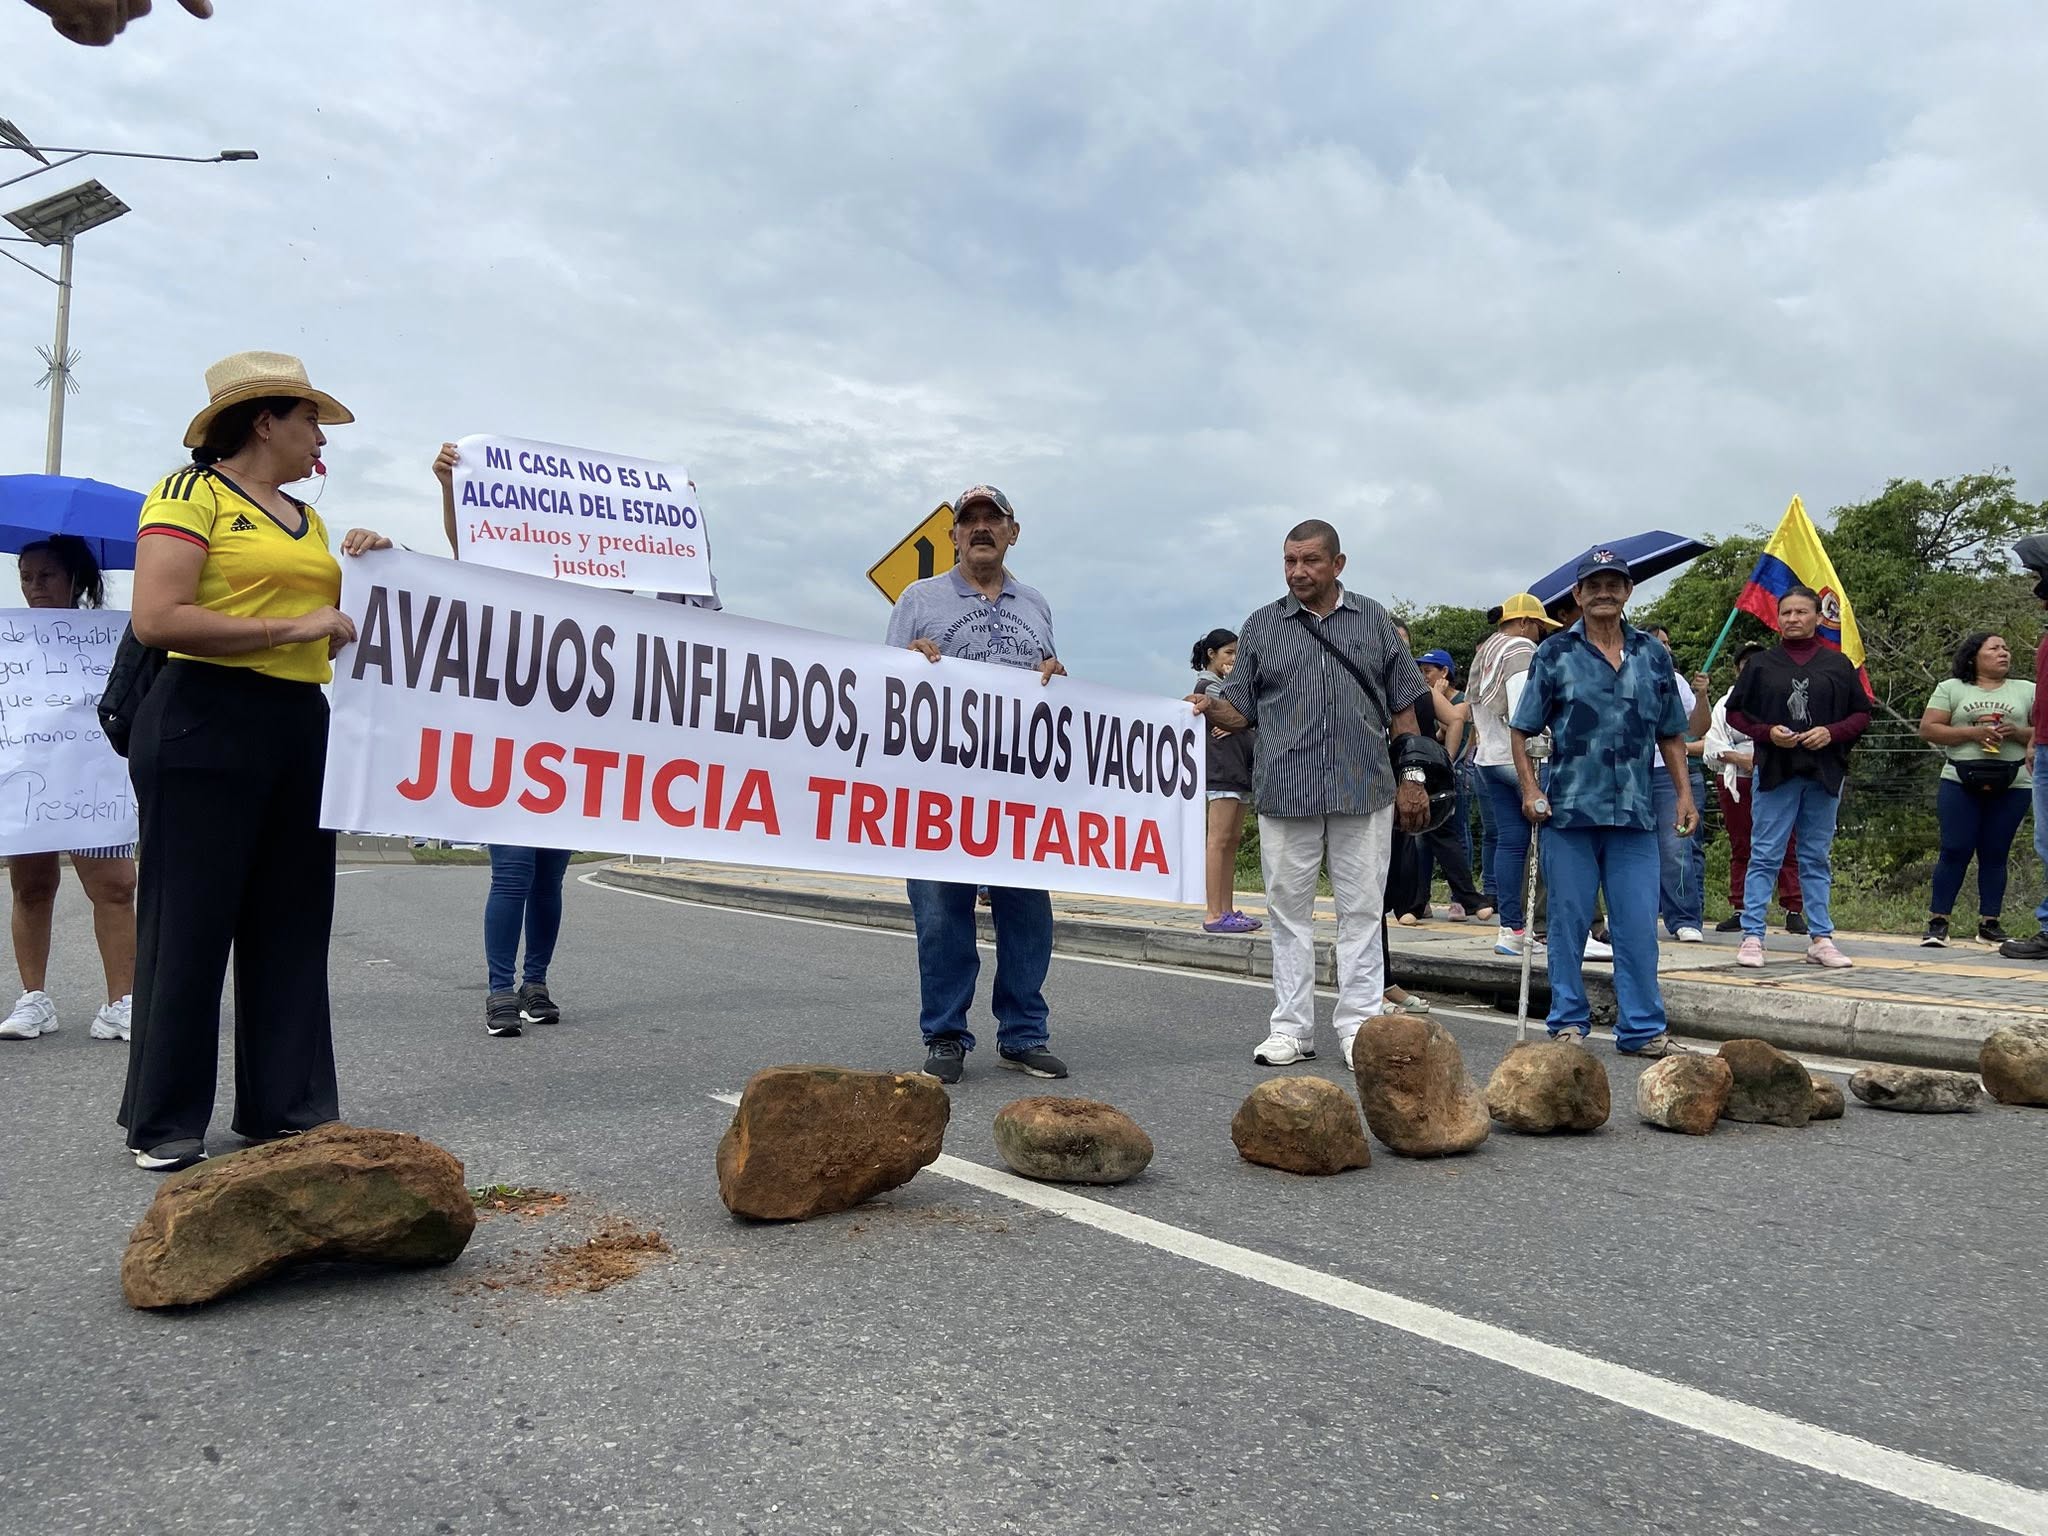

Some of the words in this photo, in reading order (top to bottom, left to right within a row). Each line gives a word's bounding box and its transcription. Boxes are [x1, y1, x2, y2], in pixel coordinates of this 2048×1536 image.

[486, 445, 512, 471] MI
[519, 452, 574, 479] CASA
[578, 461, 612, 484] NO
[617, 467, 641, 488] ES
[645, 471, 672, 492] LA
[462, 480, 573, 515] ALCANCIA
[579, 493, 617, 521] DEL
[623, 499, 697, 529] ESTADO
[470, 519, 572, 545] ¡Avaluos
[578, 533, 591, 552] y
[598, 532, 696, 558] prediales
[553, 553, 626, 578] justos!
[1, 620, 25, 643] de
[33, 624, 50, 645] la
[1000, 609, 1041, 646] OARDWALK
[351, 585, 616, 718] AVALUOS
[632, 633, 869, 768] INFLADOS,
[883, 676, 1072, 783] BOLSILLOS
[1083, 711, 1198, 801] VACIOS
[1963, 702, 2014, 713] BASKETBALL
[85, 729, 108, 742] co
[396, 727, 781, 836] JUSTICIA
[808, 776, 1170, 875] TRIBUTARIA
